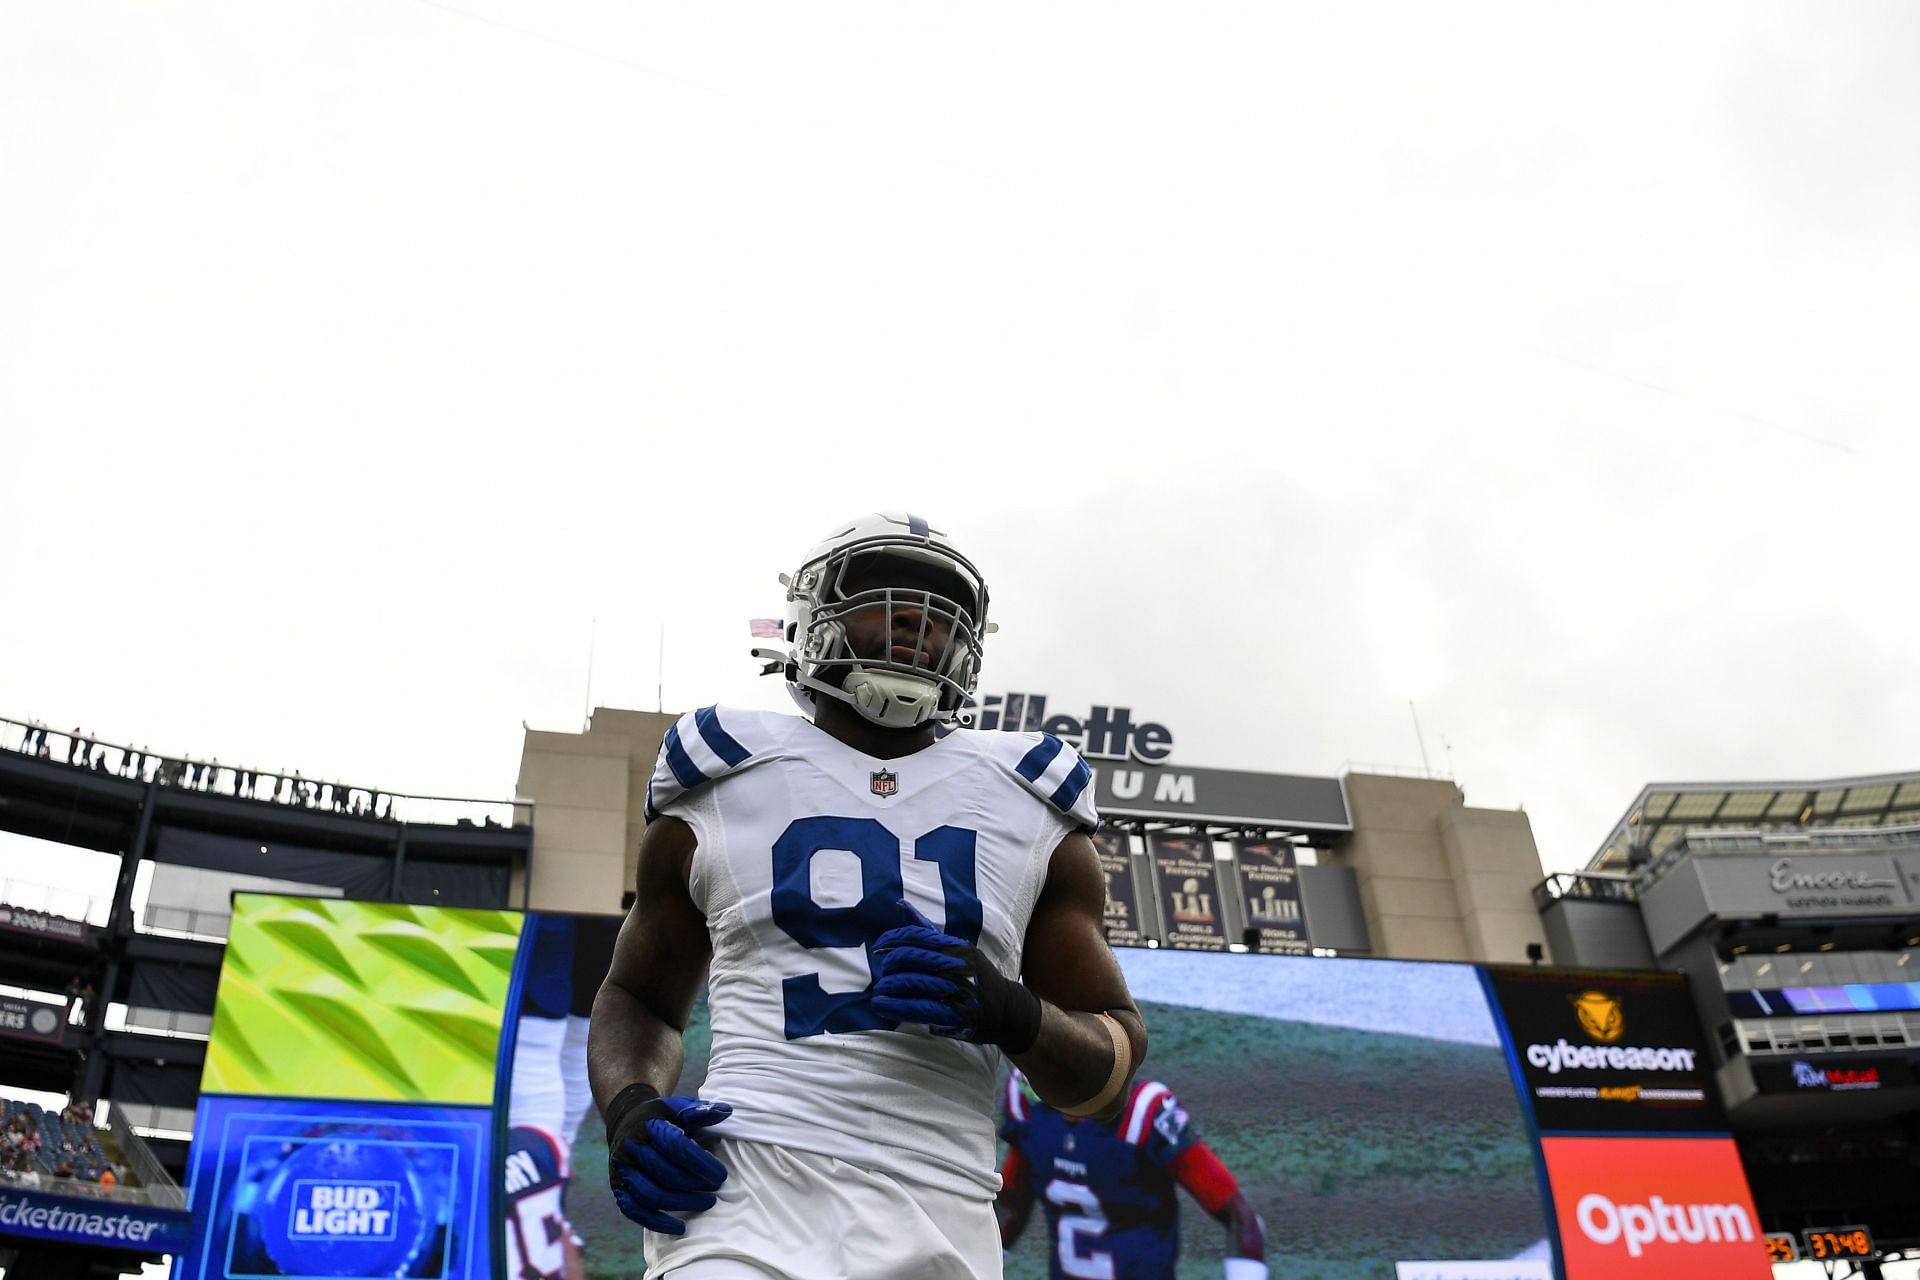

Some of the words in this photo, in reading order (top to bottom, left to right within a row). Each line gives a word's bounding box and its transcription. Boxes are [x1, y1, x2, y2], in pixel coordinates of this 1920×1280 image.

[937, 692, 1174, 765] illette
[874, 780, 895, 792] NFL
[1092, 767, 1196, 804] UM
[1769, 857, 1897, 894] Encore
[771, 815, 984, 1041] 91
[1527, 1038, 1696, 1074] cybereason
[311, 1186, 380, 1210] BUD
[295, 1208, 391, 1235] LIGHT
[1045, 1178, 1117, 1280] 2
[1576, 1193, 1755, 1258] Optum
